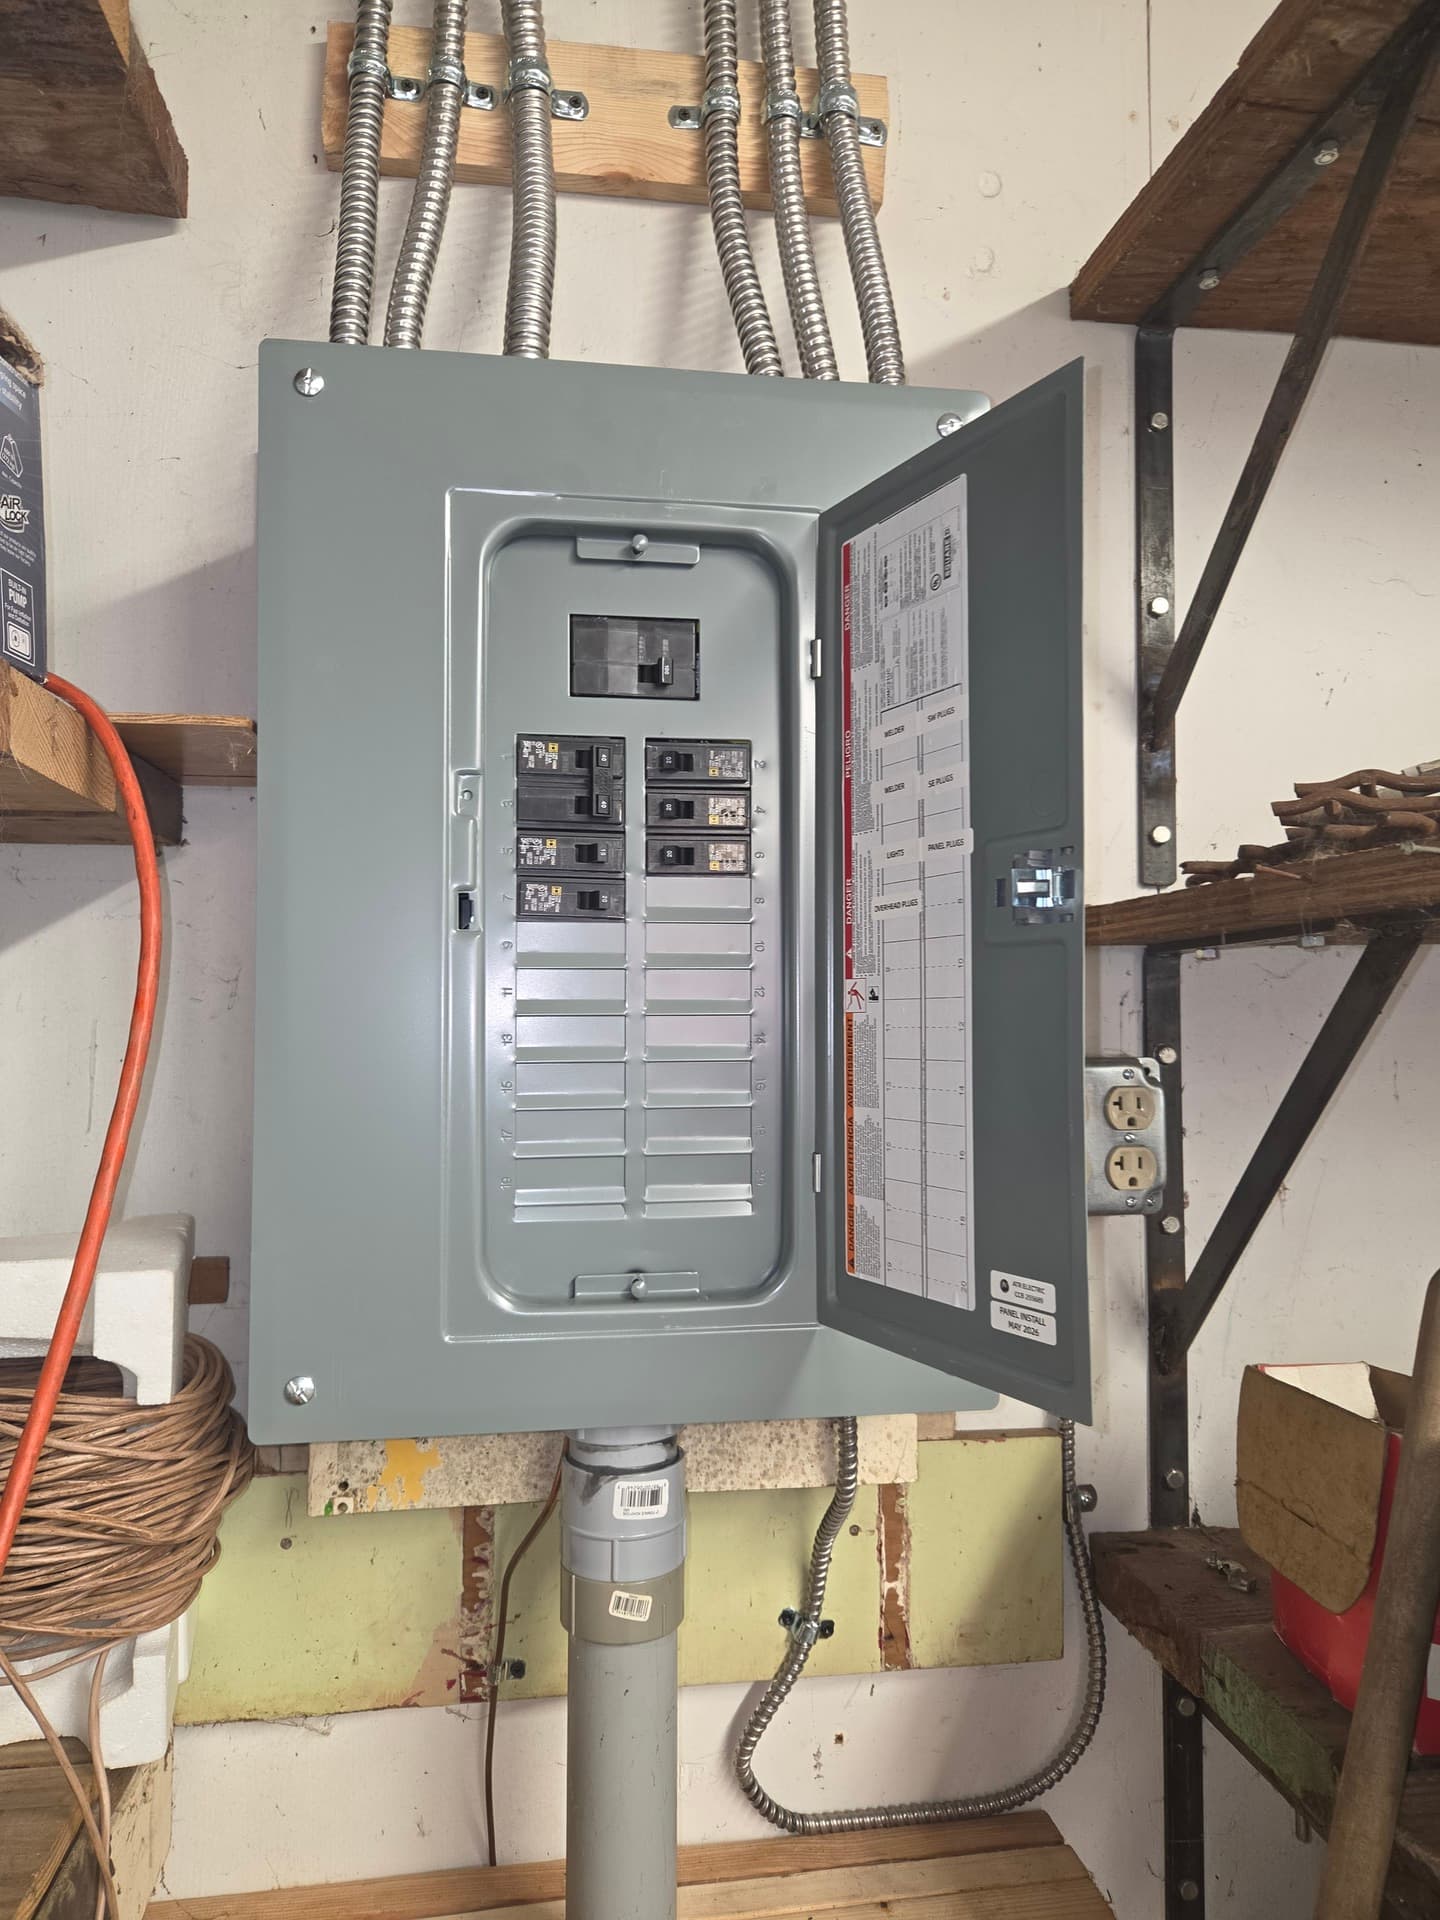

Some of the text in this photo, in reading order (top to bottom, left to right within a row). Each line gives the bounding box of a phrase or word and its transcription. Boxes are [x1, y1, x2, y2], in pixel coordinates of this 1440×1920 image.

[5, 510, 27, 522] LOCK
[8, 579, 27, 595] BUILT-IN
[9, 589, 27, 608] PUMP
[937, 706, 956, 720] PLUGS
[884, 724, 905, 738] WELDER
[601, 754, 607, 762] 40
[754, 760, 766, 769] 2
[935, 773, 954, 787] PLUGS
[884, 781, 905, 794] WELDER
[600, 801, 607, 809] 40
[665, 803, 672, 811] 20
[754, 806, 766, 814] 4
[928, 837, 965, 852] PANEL PLUGS
[666, 850, 673, 858] 20
[754, 851, 765, 859] 6
[886, 847, 905, 860] LIGHTS
[502, 893, 513, 902] 7
[874, 898, 918, 913] OVERHEAD PLUGS
[502, 940, 513, 949] 9
[754, 940, 765, 952] 10
[958, 957, 965, 968] 10
[501, 987, 512, 998] 11
[754, 986, 765, 998] 12
[885, 1023, 891, 1032] 11
[958, 1022, 965, 1031] 12
[501, 1033, 512, 1046] 13
[753, 1032, 766, 1045] 14
[958, 1085, 965, 1095] 14
[500, 1128, 512, 1142] 17
[500, 1176, 512, 1191] 19
[960, 1280, 967, 1293] 20
[1023, 1282, 1046, 1295] ELECTRIC
[999, 1306, 1047, 1327] PANEL INSTALL
[1008, 1320, 1022, 1332] MAY
